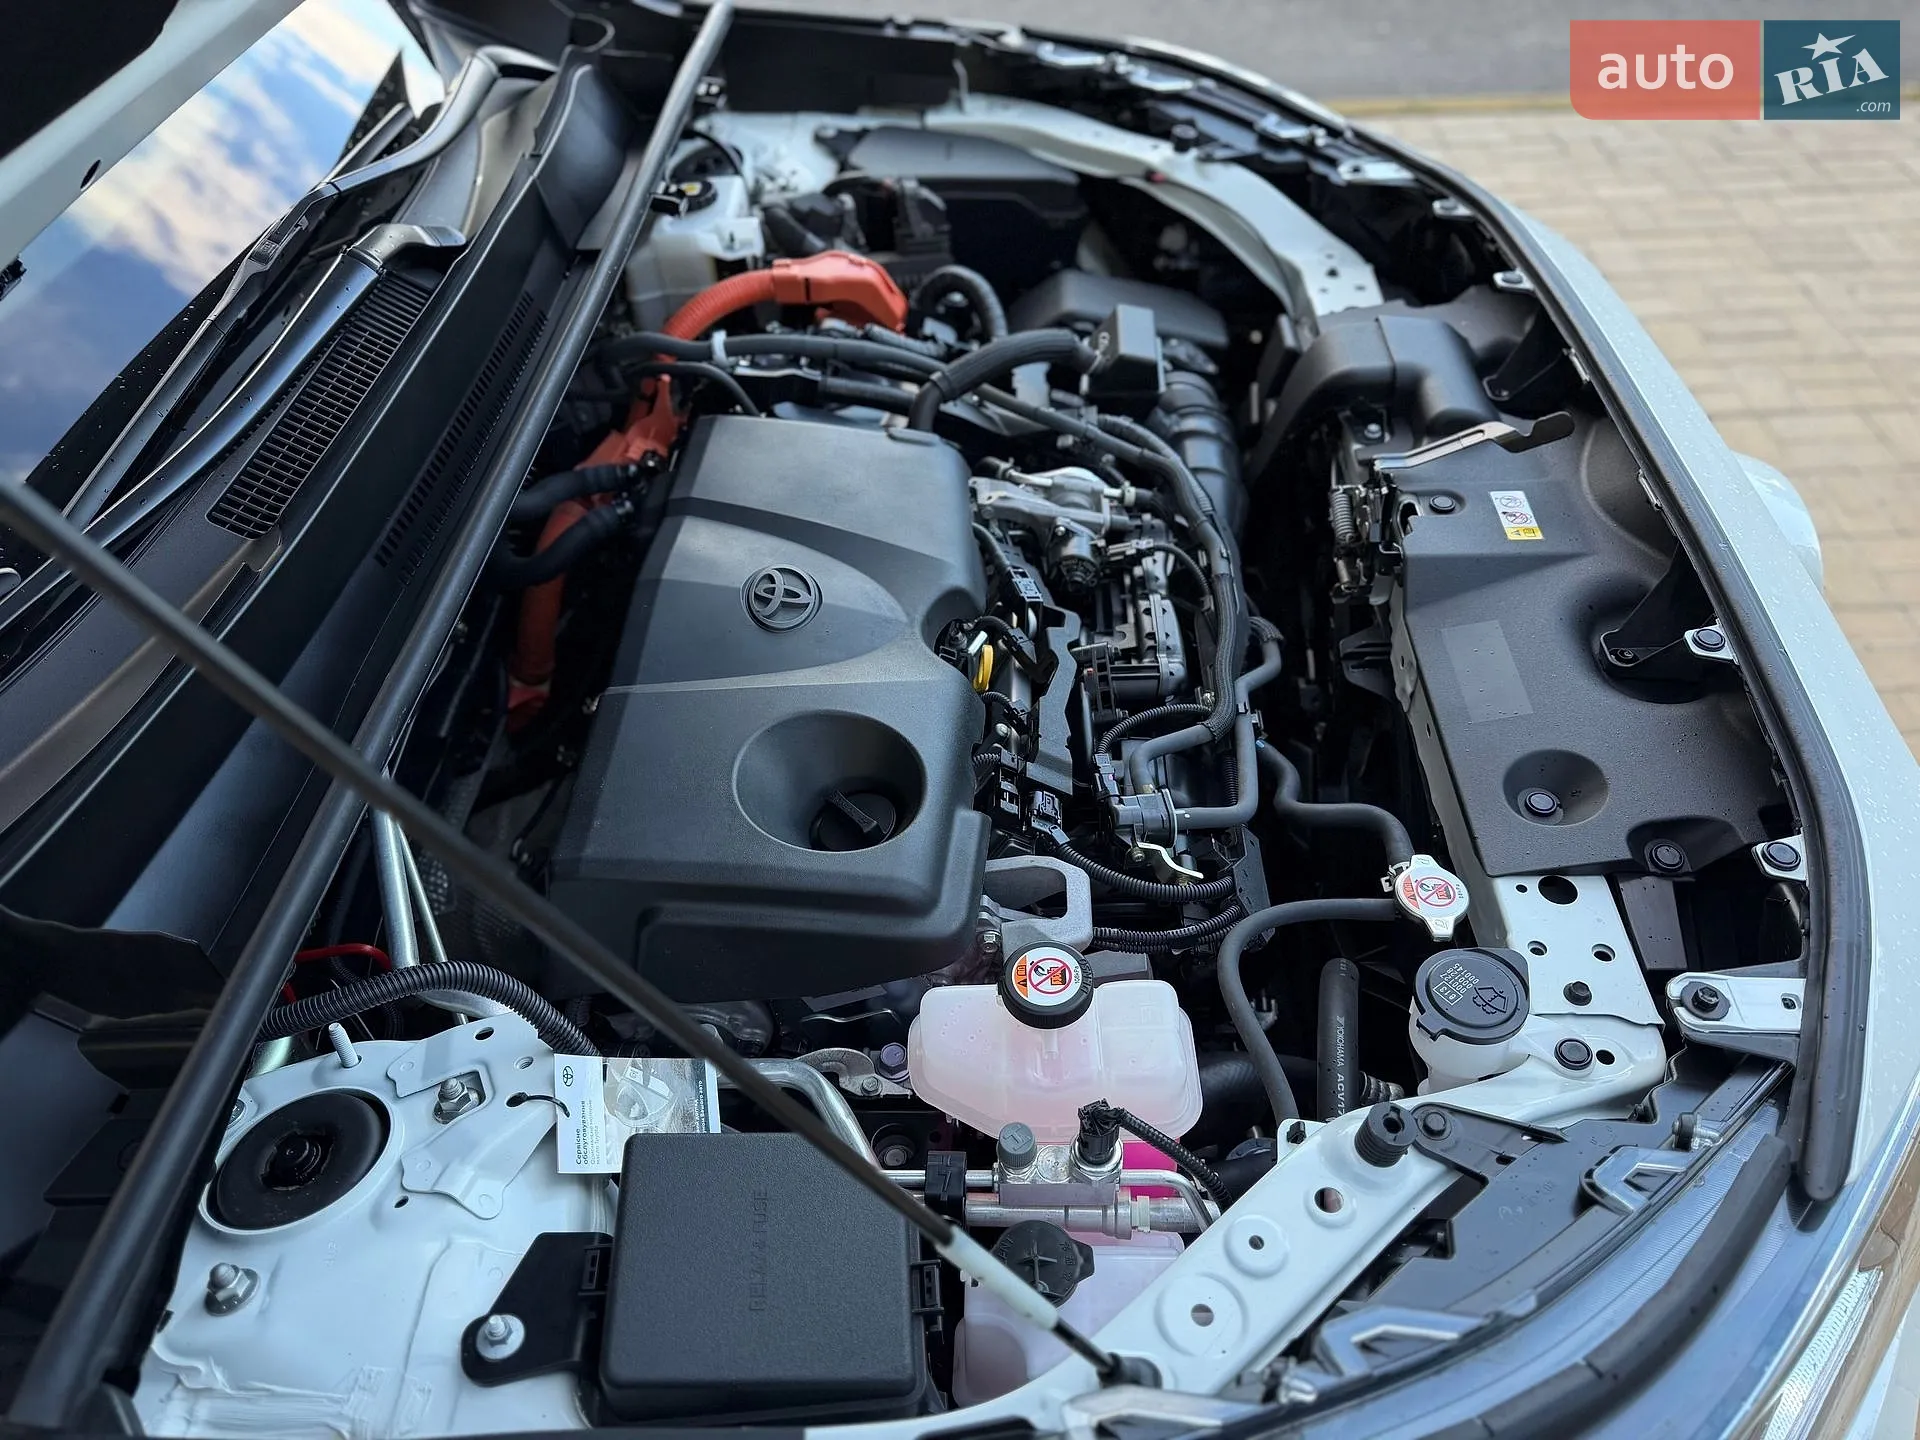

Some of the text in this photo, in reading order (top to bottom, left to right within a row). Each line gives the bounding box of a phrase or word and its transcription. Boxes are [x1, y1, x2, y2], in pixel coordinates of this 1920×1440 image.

[1079, 958, 1092, 995] DENSO
[1440, 973, 1467, 994] 000127
[1446, 967, 1473, 989] 000128
[1453, 963, 1480, 985] 000145
[1336, 1025, 1345, 1068] YOKOHAMA
[580, 1100, 589, 1165] обслуговування
